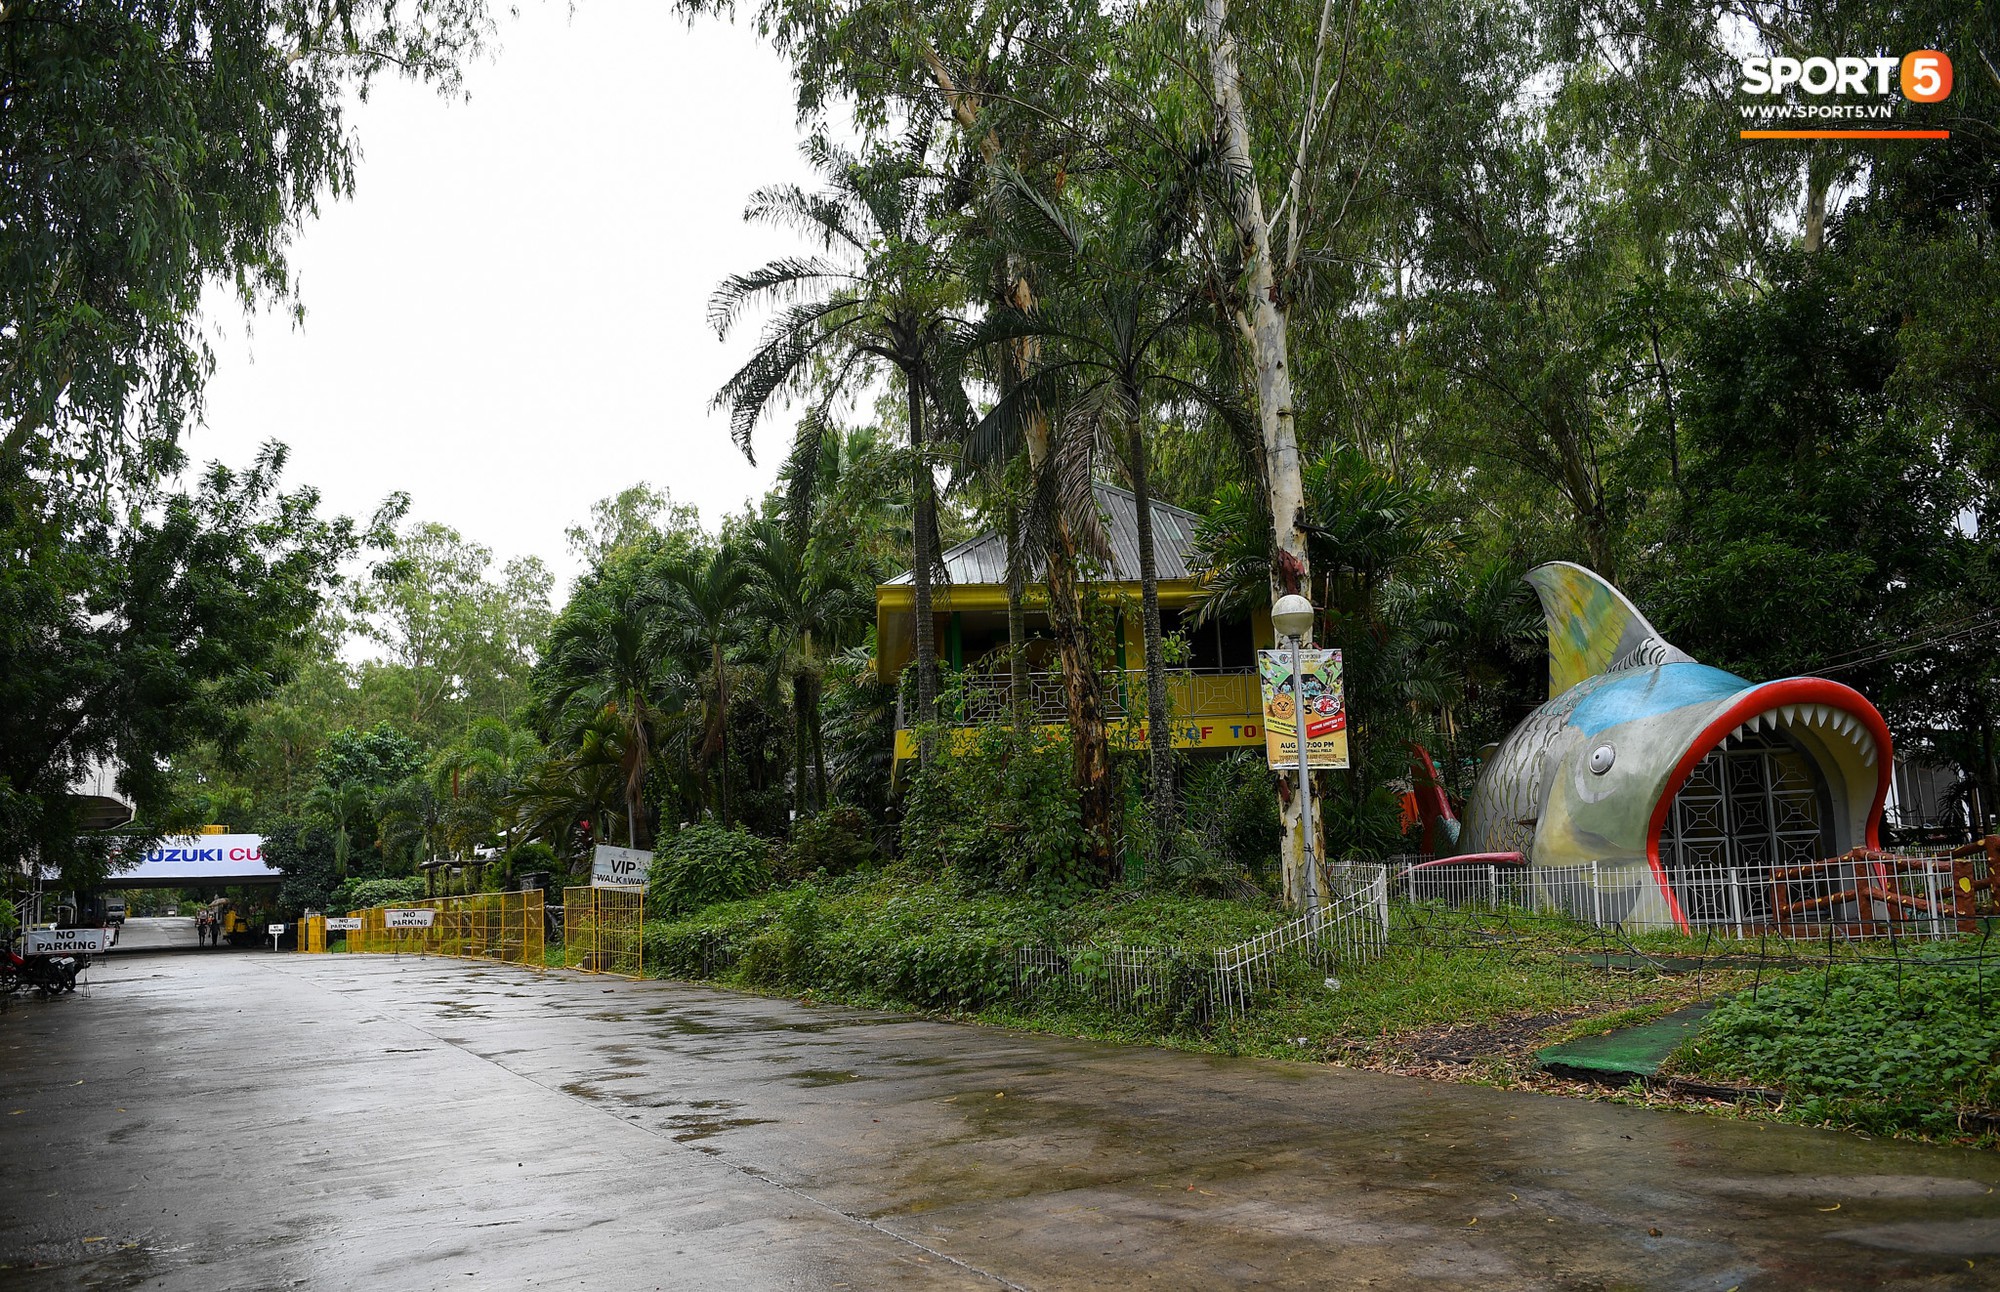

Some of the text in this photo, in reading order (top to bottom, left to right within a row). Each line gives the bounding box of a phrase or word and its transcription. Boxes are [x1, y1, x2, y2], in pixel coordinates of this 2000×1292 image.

[1303, 705, 1312, 714] S
[229, 847, 266, 861] CU
[611, 860, 636, 874] VIP
[392, 918, 428, 926] PARKING
[55, 930, 76, 940] NO
[37, 941, 97, 951] PARKING
